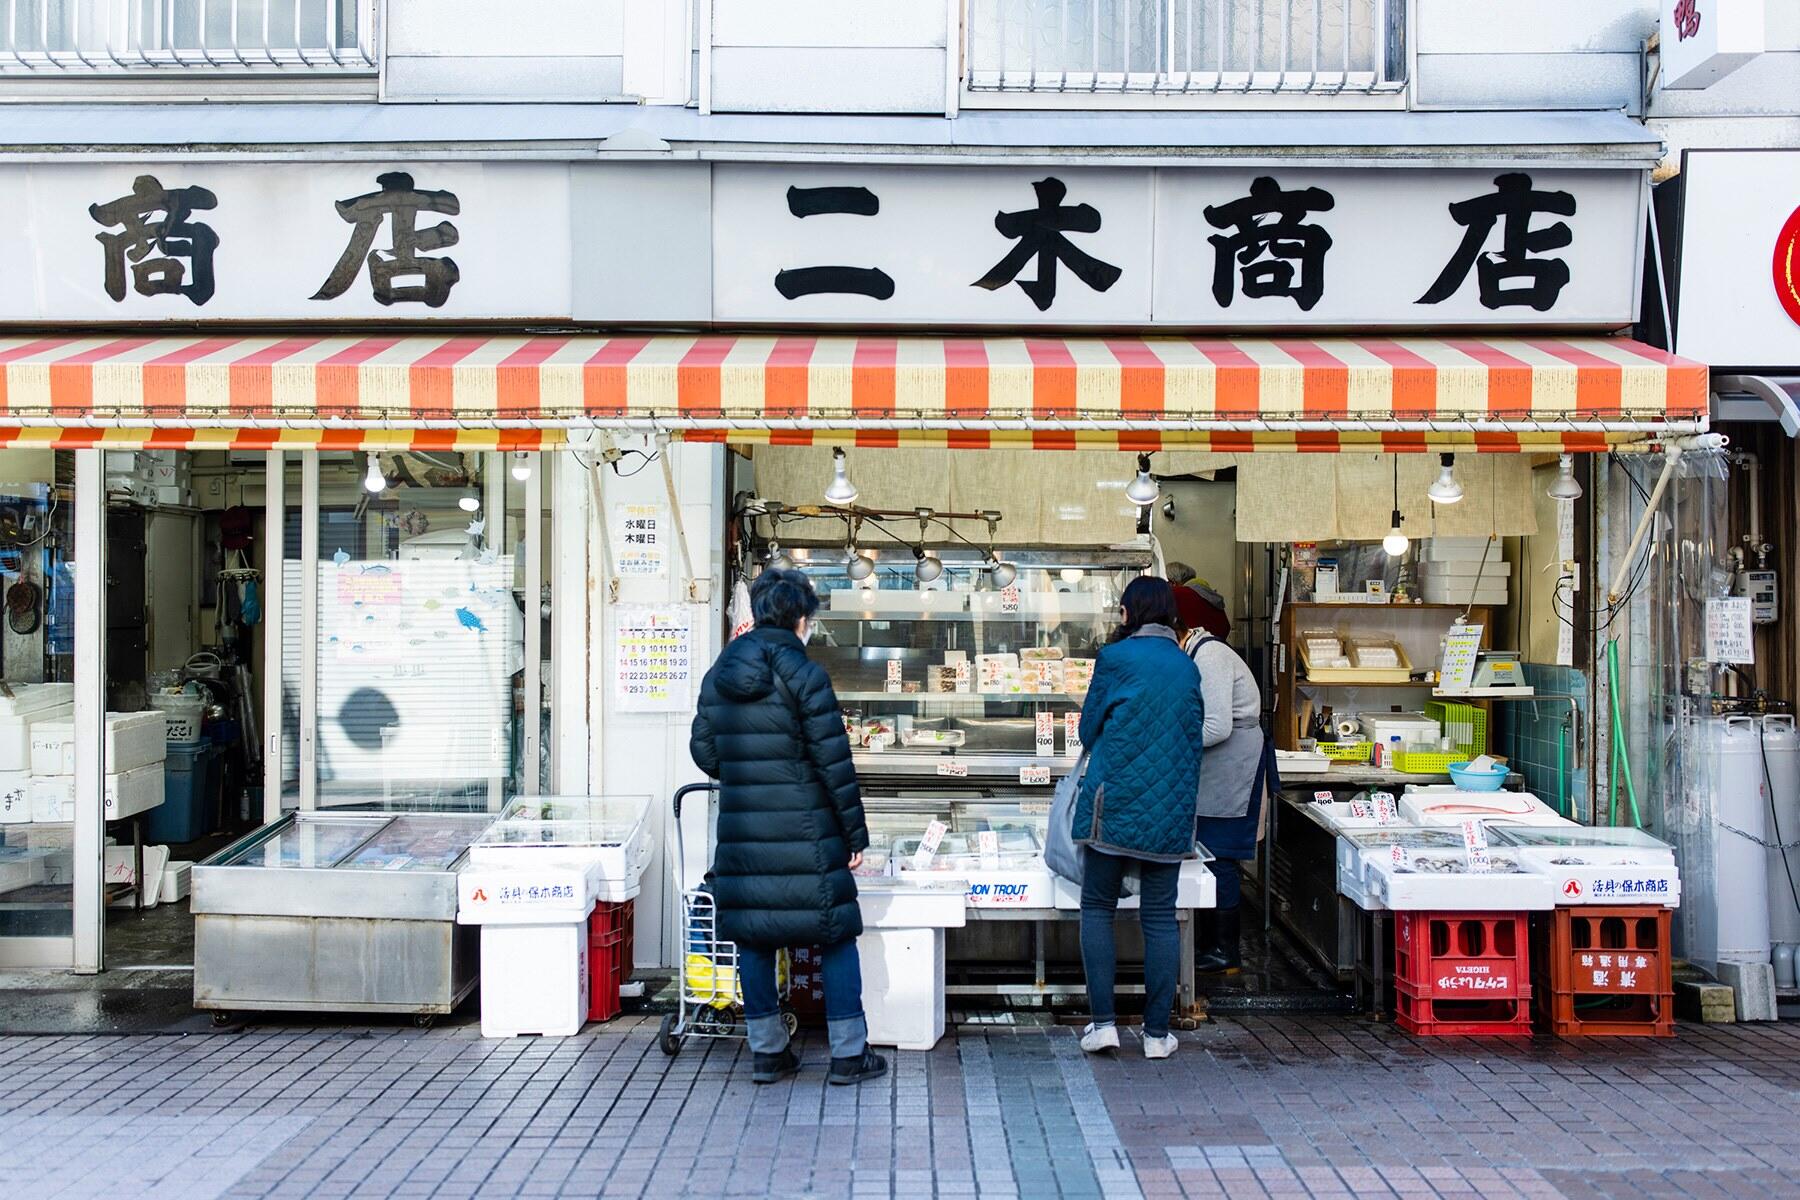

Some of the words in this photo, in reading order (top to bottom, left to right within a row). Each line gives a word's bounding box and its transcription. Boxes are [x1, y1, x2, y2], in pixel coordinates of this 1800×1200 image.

[90, 171, 461, 307] 商店
[774, 172, 1577, 311] 二木商店
[625, 519, 656, 530] 水曜日
[625, 533, 656, 544] 木曜日
[630, 672, 638, 680] 22
[640, 672, 648, 680] 23
[650, 672, 658, 680] 24
[660, 672, 668, 680] 25
[669, 672, 678, 680] 26
[679, 672, 687, 680] 27
[630, 686, 638, 694] 29
[650, 686, 658, 694] 31
[993, 884, 1028, 895] TROUT
[1455, 965, 1490, 974] HIGETA
[1438, 975, 1508, 989] ヒゲタしょうゆ
[1592, 969, 1636, 988] 清酒
